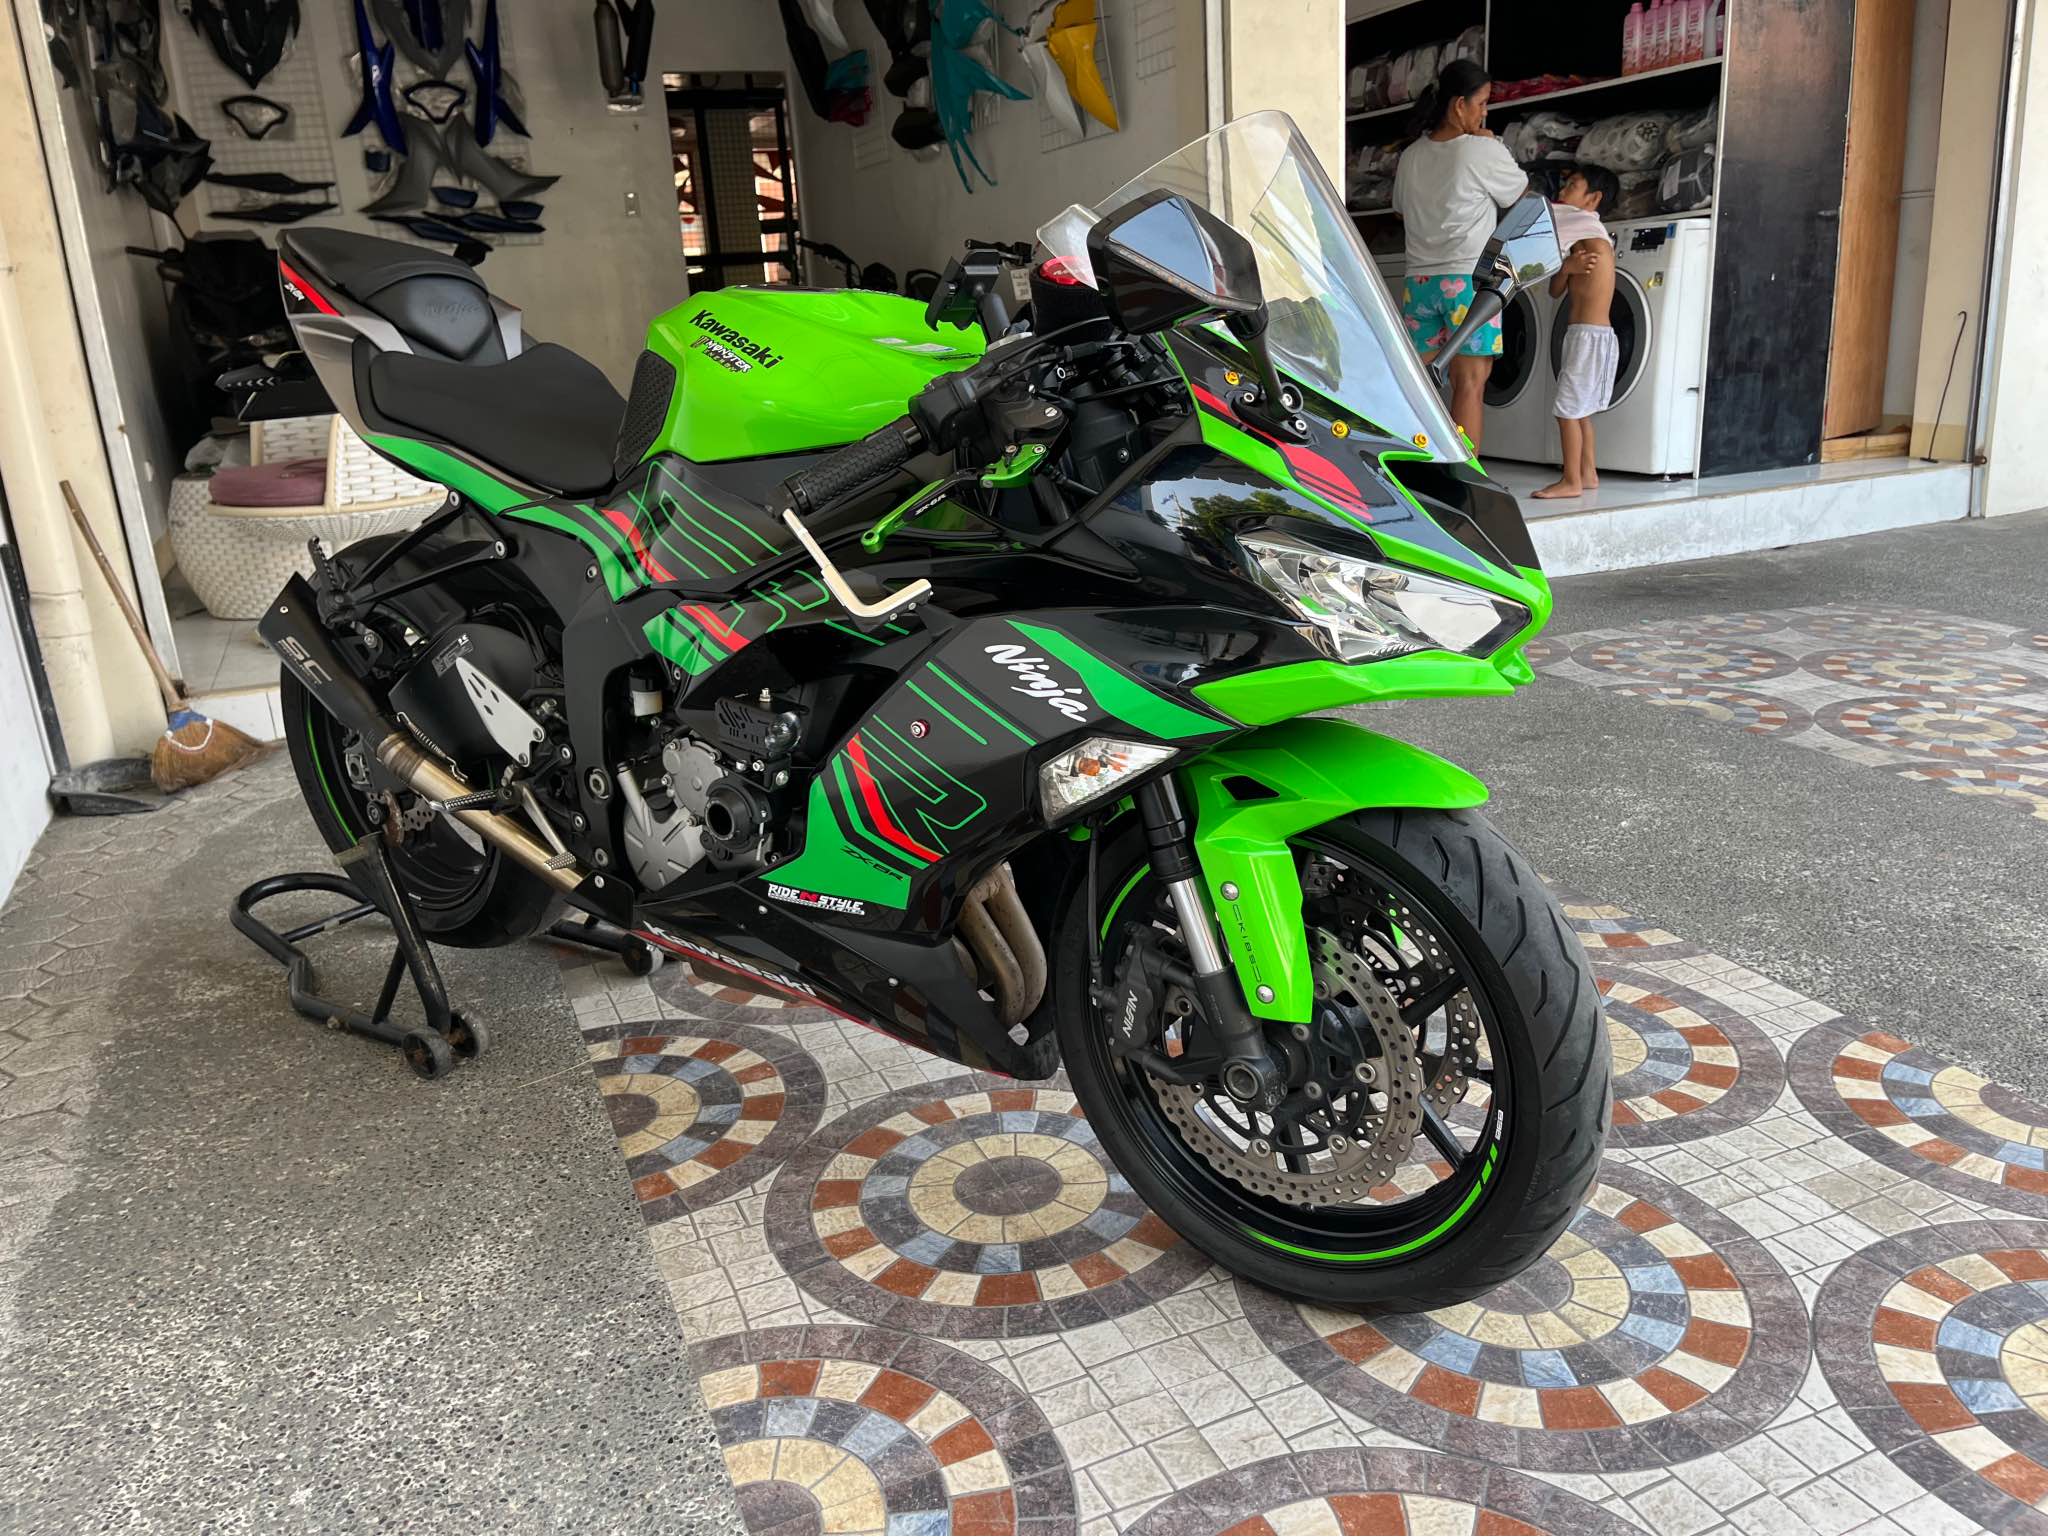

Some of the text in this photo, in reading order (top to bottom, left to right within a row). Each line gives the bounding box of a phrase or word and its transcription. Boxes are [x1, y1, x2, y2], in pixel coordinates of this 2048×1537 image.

[688, 309, 785, 369] Kawasaki
[705, 340, 753, 373] MONSTER
[281, 636, 333, 684] SC
[984, 644, 1088, 723] Ninja
[841, 845, 903, 881] ZX-6R
[768, 883, 800, 899] RIDE
[819, 895, 864, 911] STYLE
[643, 920, 817, 997] Kawasaki
